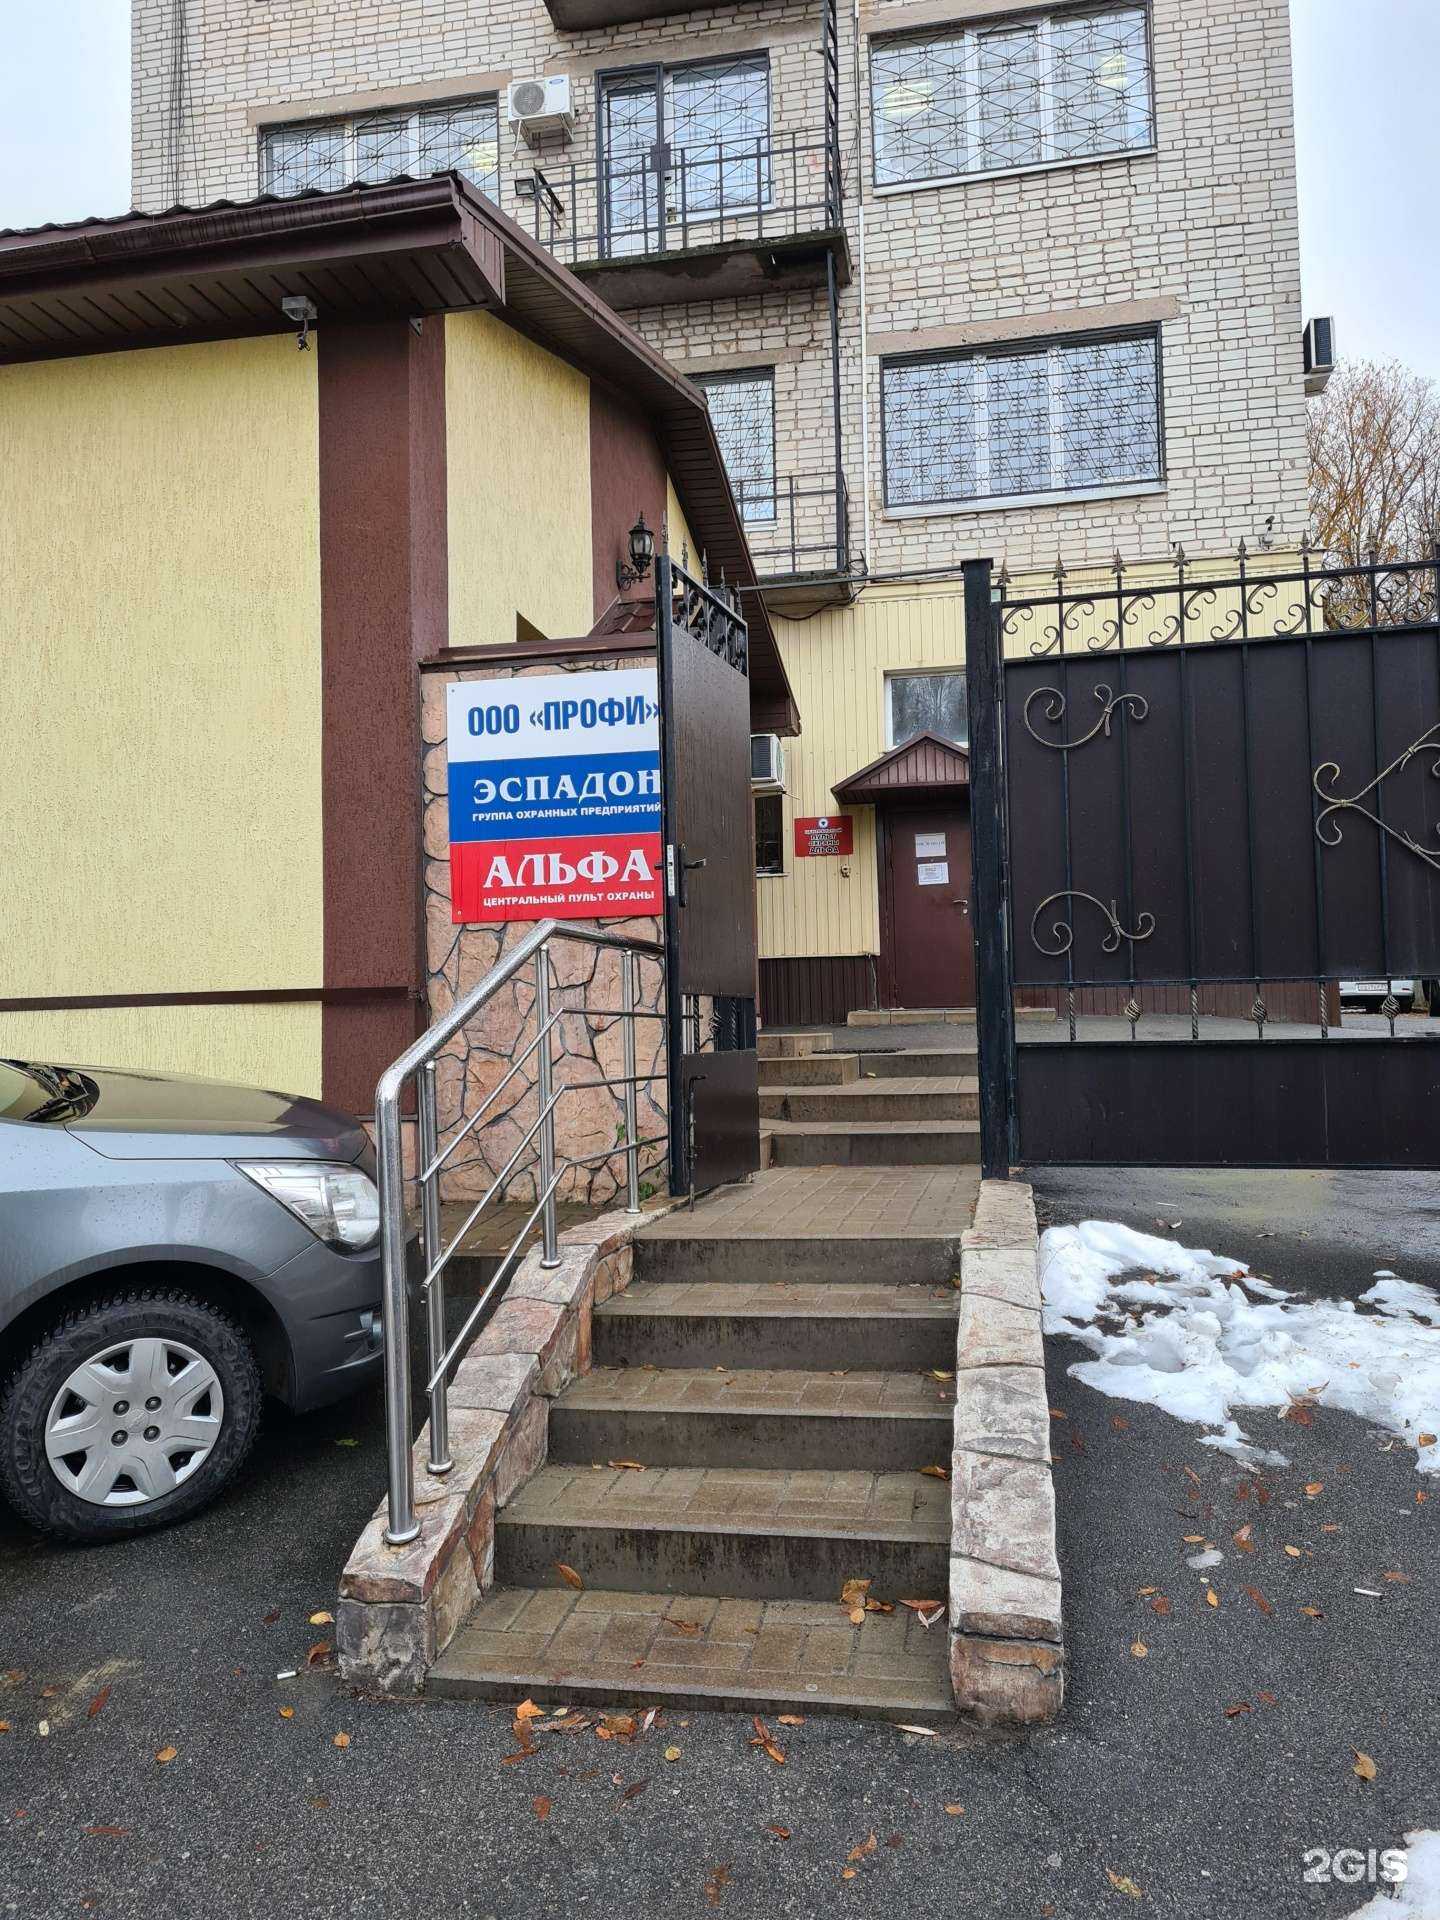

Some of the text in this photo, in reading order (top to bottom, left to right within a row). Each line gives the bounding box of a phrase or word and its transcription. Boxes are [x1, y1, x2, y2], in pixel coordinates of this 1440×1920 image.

[467, 695, 660, 737] ООО «ПРОФИ»
[473, 769, 661, 804] ЭСПАДОН
[472, 801, 662, 822] ГРУППА ОХРАННЫХ ПРЕДПРИЯТИЙ
[483, 849, 655, 889] АЛЬФА
[483, 890, 655, 907] ЦЕНТРАЛЬНЫЙ ПУЛЬТ ОХРАНЫ
